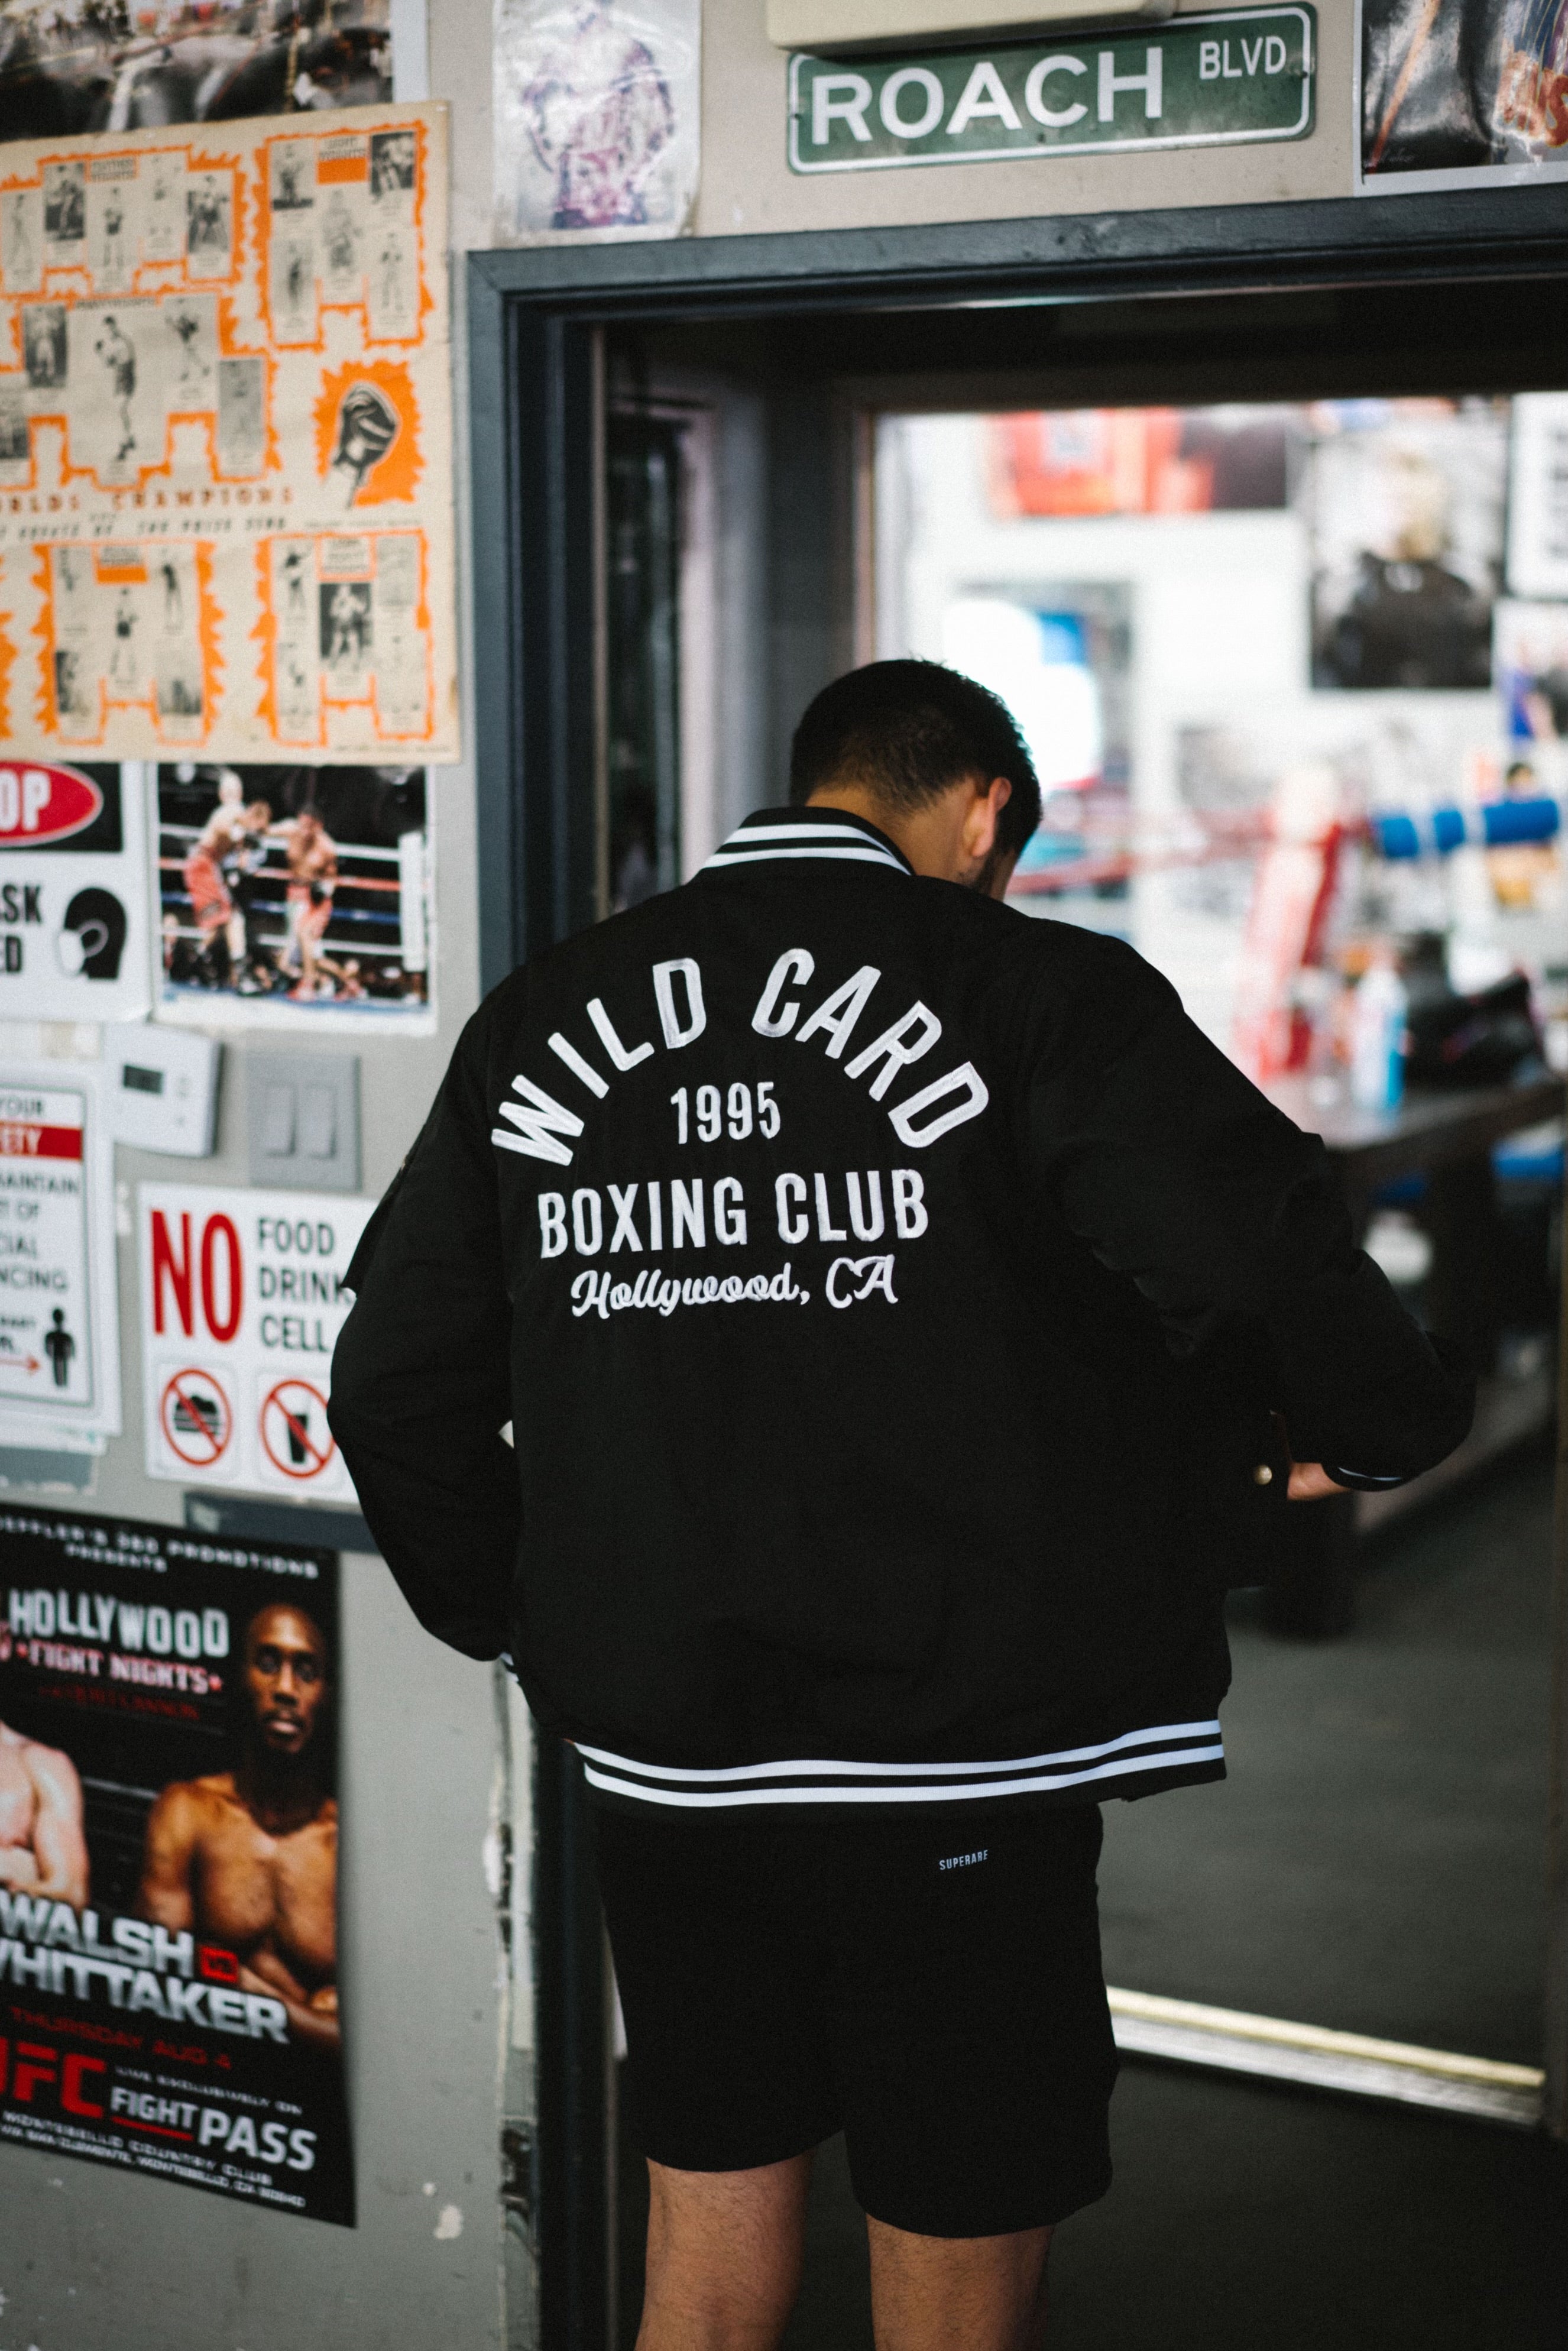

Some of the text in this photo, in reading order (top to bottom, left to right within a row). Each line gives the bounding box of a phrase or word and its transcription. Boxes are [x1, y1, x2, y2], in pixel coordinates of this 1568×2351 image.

[811, 35, 1288, 145] ROACH BLVD
[491, 947, 990, 1167] WILD CARD
[670, 1081, 782, 1145] 1995
[537, 1169, 929, 1259] BOXING CLUB
[151, 1209, 335, 1343] NO FOOD
[260, 1265, 351, 1306] DRINK
[571, 1254, 899, 1320] Hollywood, CA
[261, 1314, 329, 1353] CELL
[64, 1542, 167, 1573] PRESENTS
[166, 1539, 319, 1580] PROMOTIONS
[9, 1589, 229, 1657] HOLLYWOOD
[29, 1639, 208, 1695] FIGHT NIGHTS
[938, 1849, 989, 1870] SUPERARE
[0, 1887, 195, 1978] WALSH
[11, 2006, 144, 2048] THURSDAY
[152, 2039, 208, 2066] AUG
[110, 2086, 199, 2129] FIGHT
[197, 2107, 318, 2172] PASS
[221, 2163, 273, 2186] CLUB
